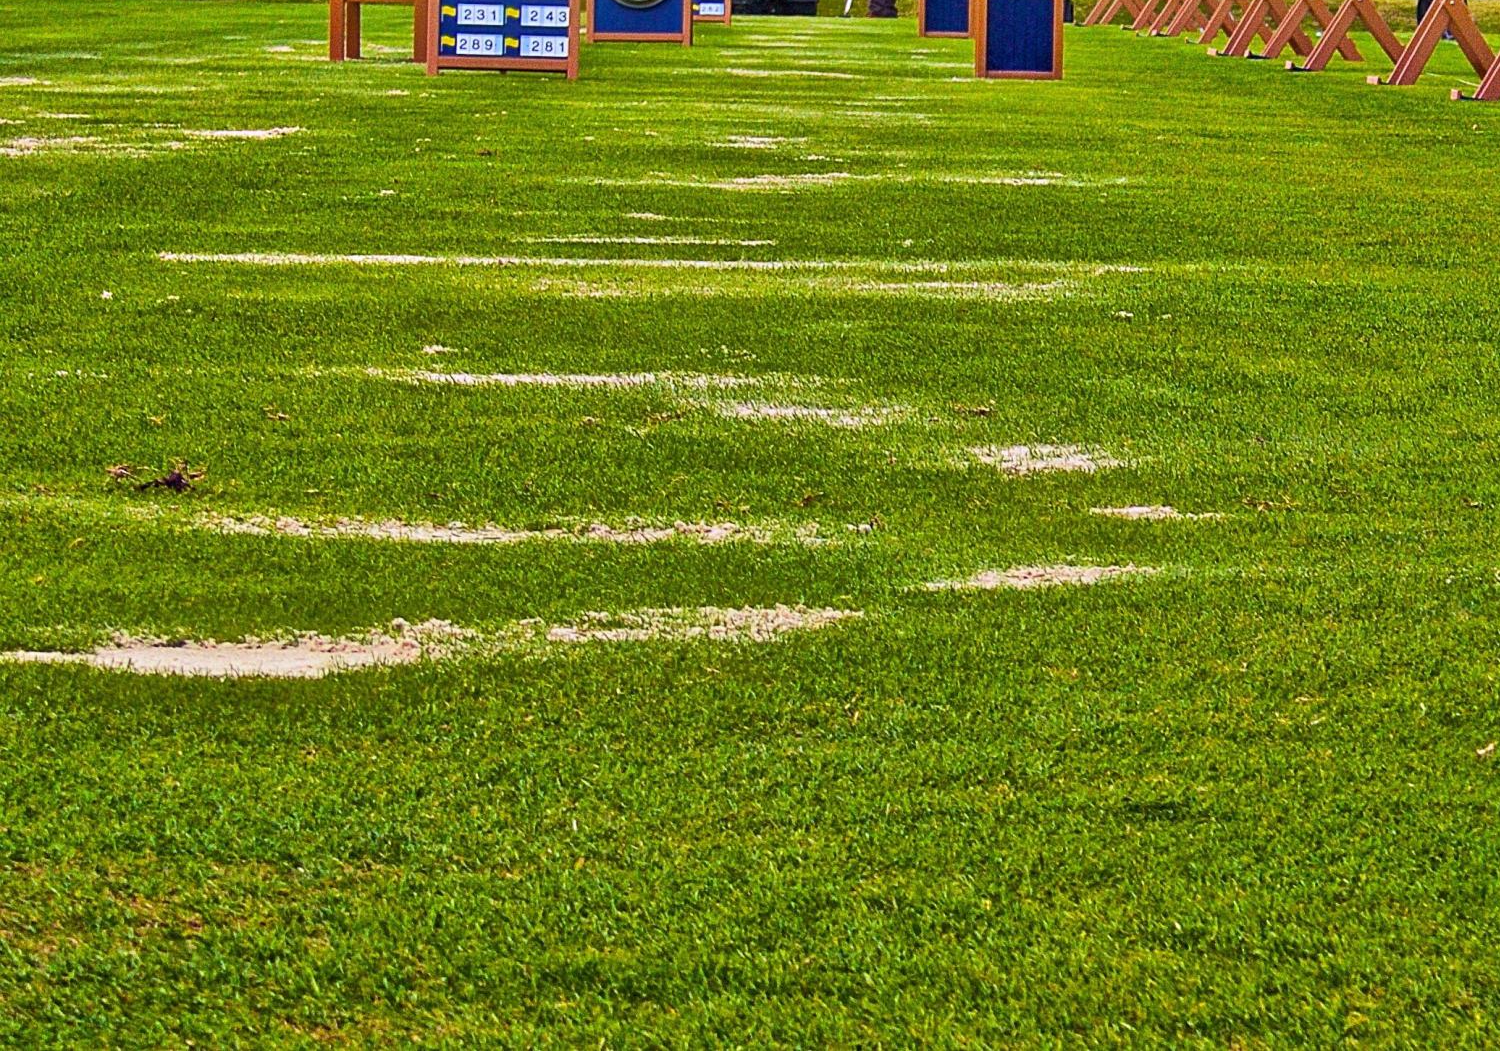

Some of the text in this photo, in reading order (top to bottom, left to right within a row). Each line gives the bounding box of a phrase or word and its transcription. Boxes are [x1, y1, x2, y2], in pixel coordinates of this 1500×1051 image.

[464, 9, 496, 20] 231
[530, 10, 567, 22] 243
[459, 39, 493, 50] 289
[531, 41, 565, 52] 281
